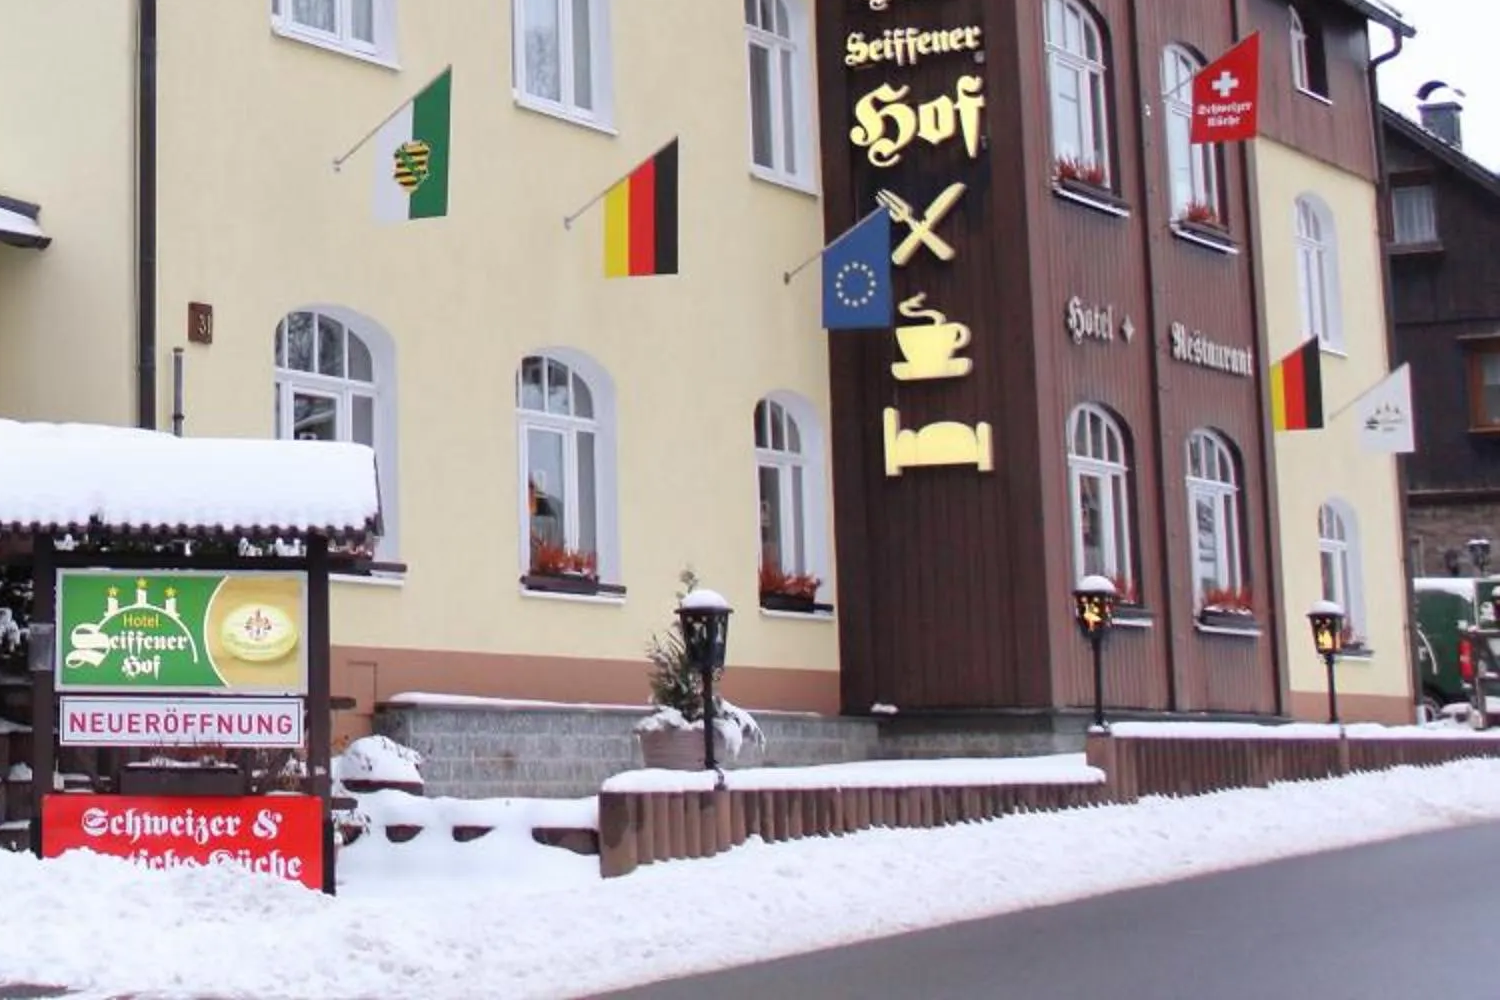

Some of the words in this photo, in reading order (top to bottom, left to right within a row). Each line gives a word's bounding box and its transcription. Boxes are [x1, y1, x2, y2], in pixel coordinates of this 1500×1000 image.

[845, 25, 982, 67] Seiffener
[850, 75, 985, 167] Hof
[1068, 296, 1114, 345] Hotel
[1171, 321, 1253, 376] Restaurant
[123, 614, 160, 628] Hotel
[65, 623, 188, 668] Seiffener
[122, 655, 161, 681] Hof
[68, 708, 294, 736] NEUERÖFFNUNG
[82, 807, 241, 844] Schweizer
[252, 808, 283, 839] &
